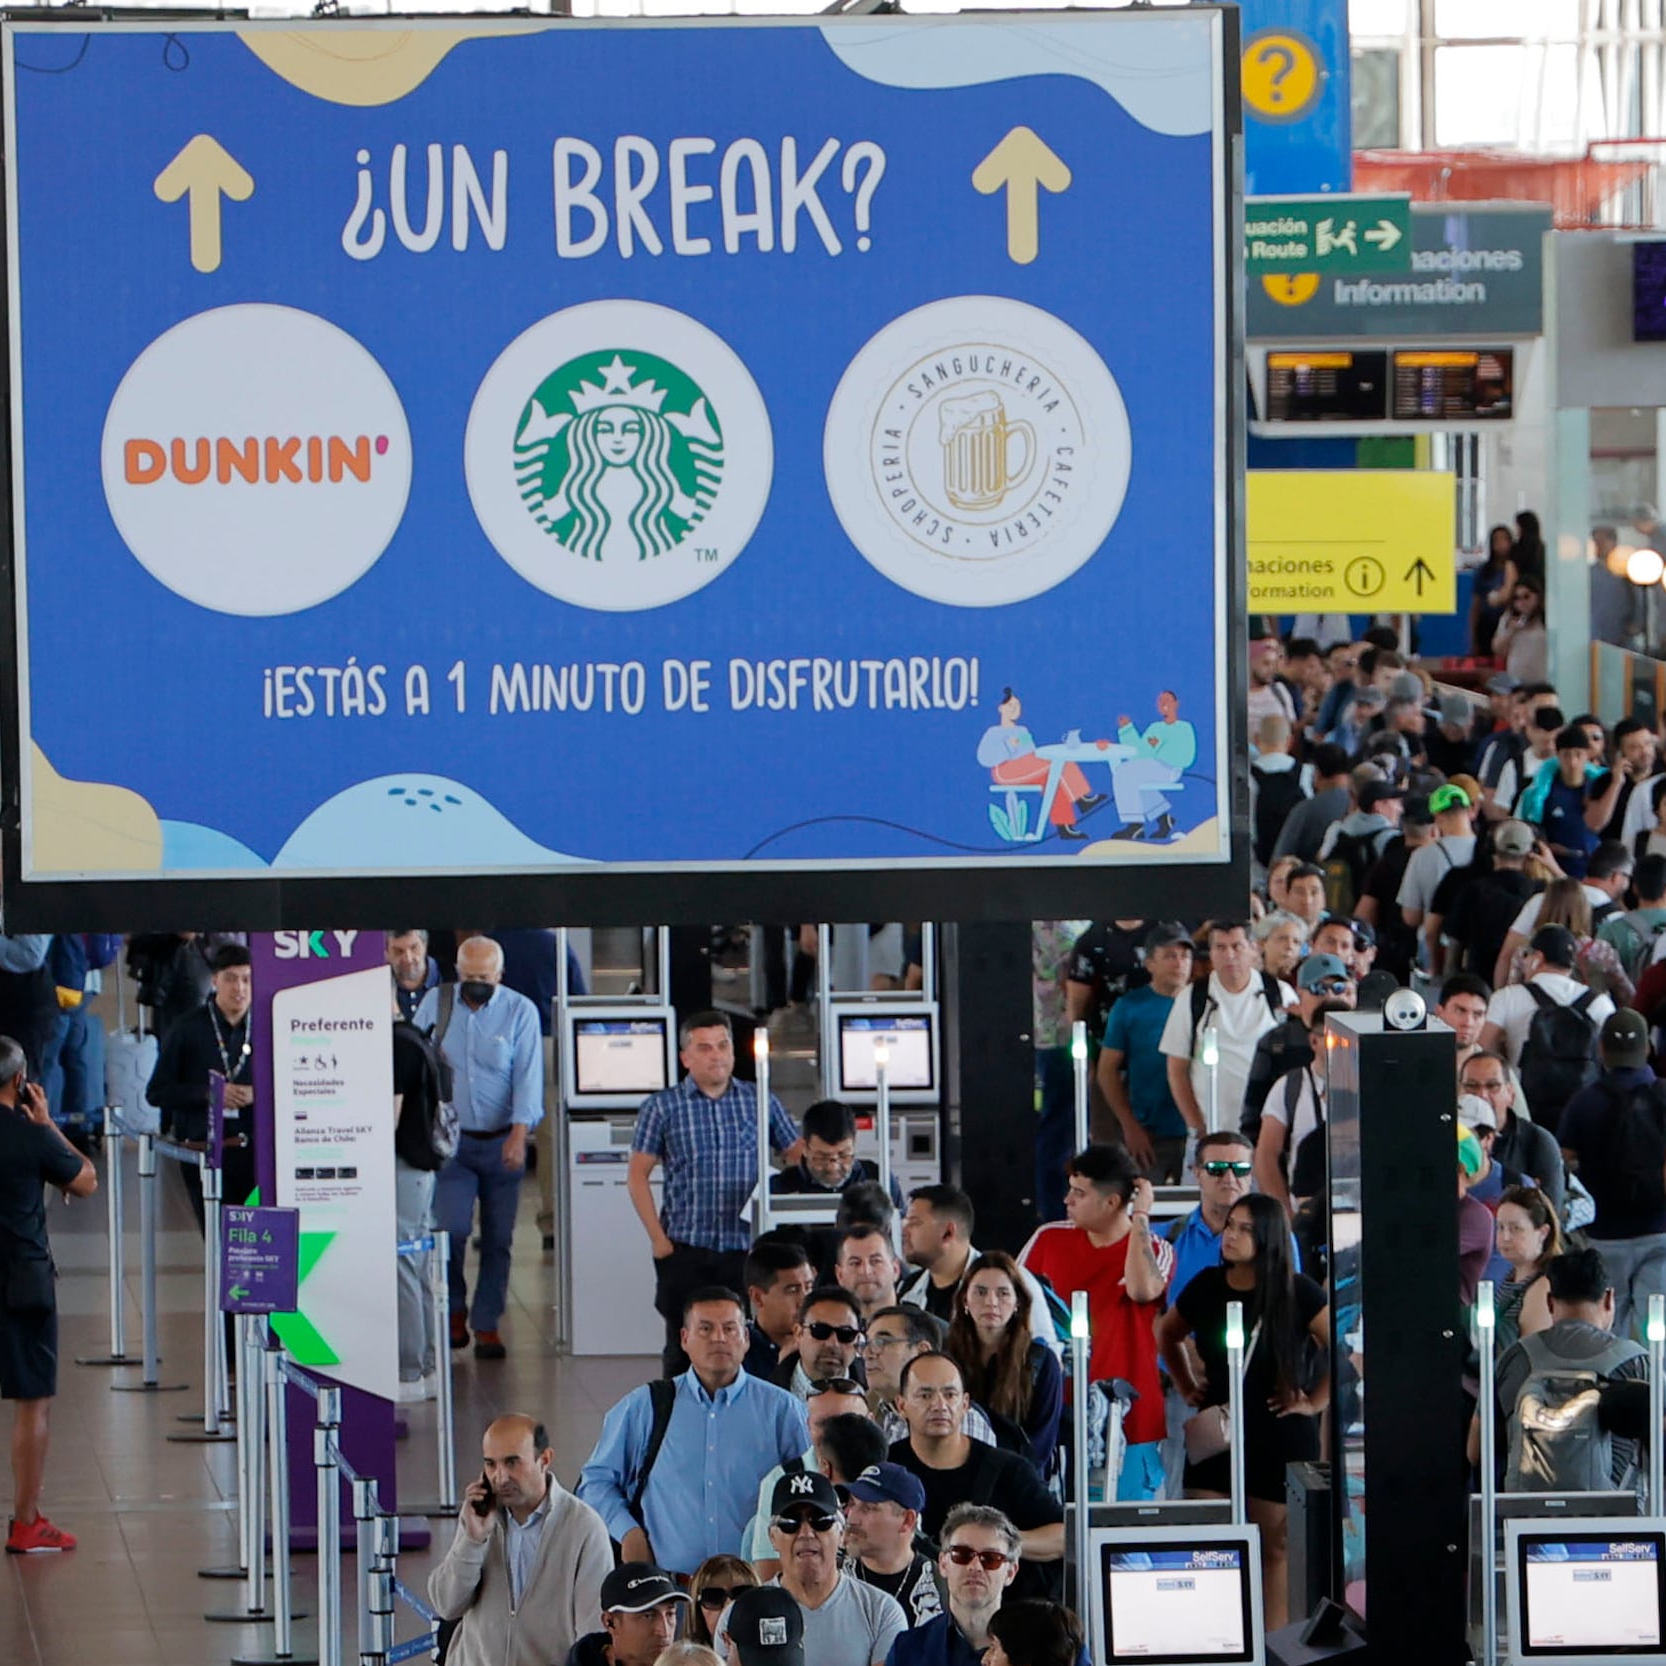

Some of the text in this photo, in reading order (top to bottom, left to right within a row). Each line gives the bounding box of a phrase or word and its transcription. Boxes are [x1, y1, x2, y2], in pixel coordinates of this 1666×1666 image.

[342, 135, 887, 261] ¿UN BREAK?
[1252, 241, 1308, 260] Route
[1334, 278, 1486, 305] Information
[908, 355, 1060, 413] SANGUCHERIA
[123, 435, 390, 486] DUNKIN'
[883, 428, 954, 544] SCHOPERIA
[990, 446, 1074, 548] CAFETERIA
[263, 655, 979, 720] ¡ESTÁS A 1 MINUTO DE DISFRUTARLO!
[274, 931, 358, 958] SKY
[290, 1018, 374, 1033] Preferente
[229, 1227, 272, 1243] Fila 4
[790, 1475, 814, 1494] NY
[1192, 1551, 1235, 1563] SelfServ
[1609, 1542, 1651, 1554] SelfServ
